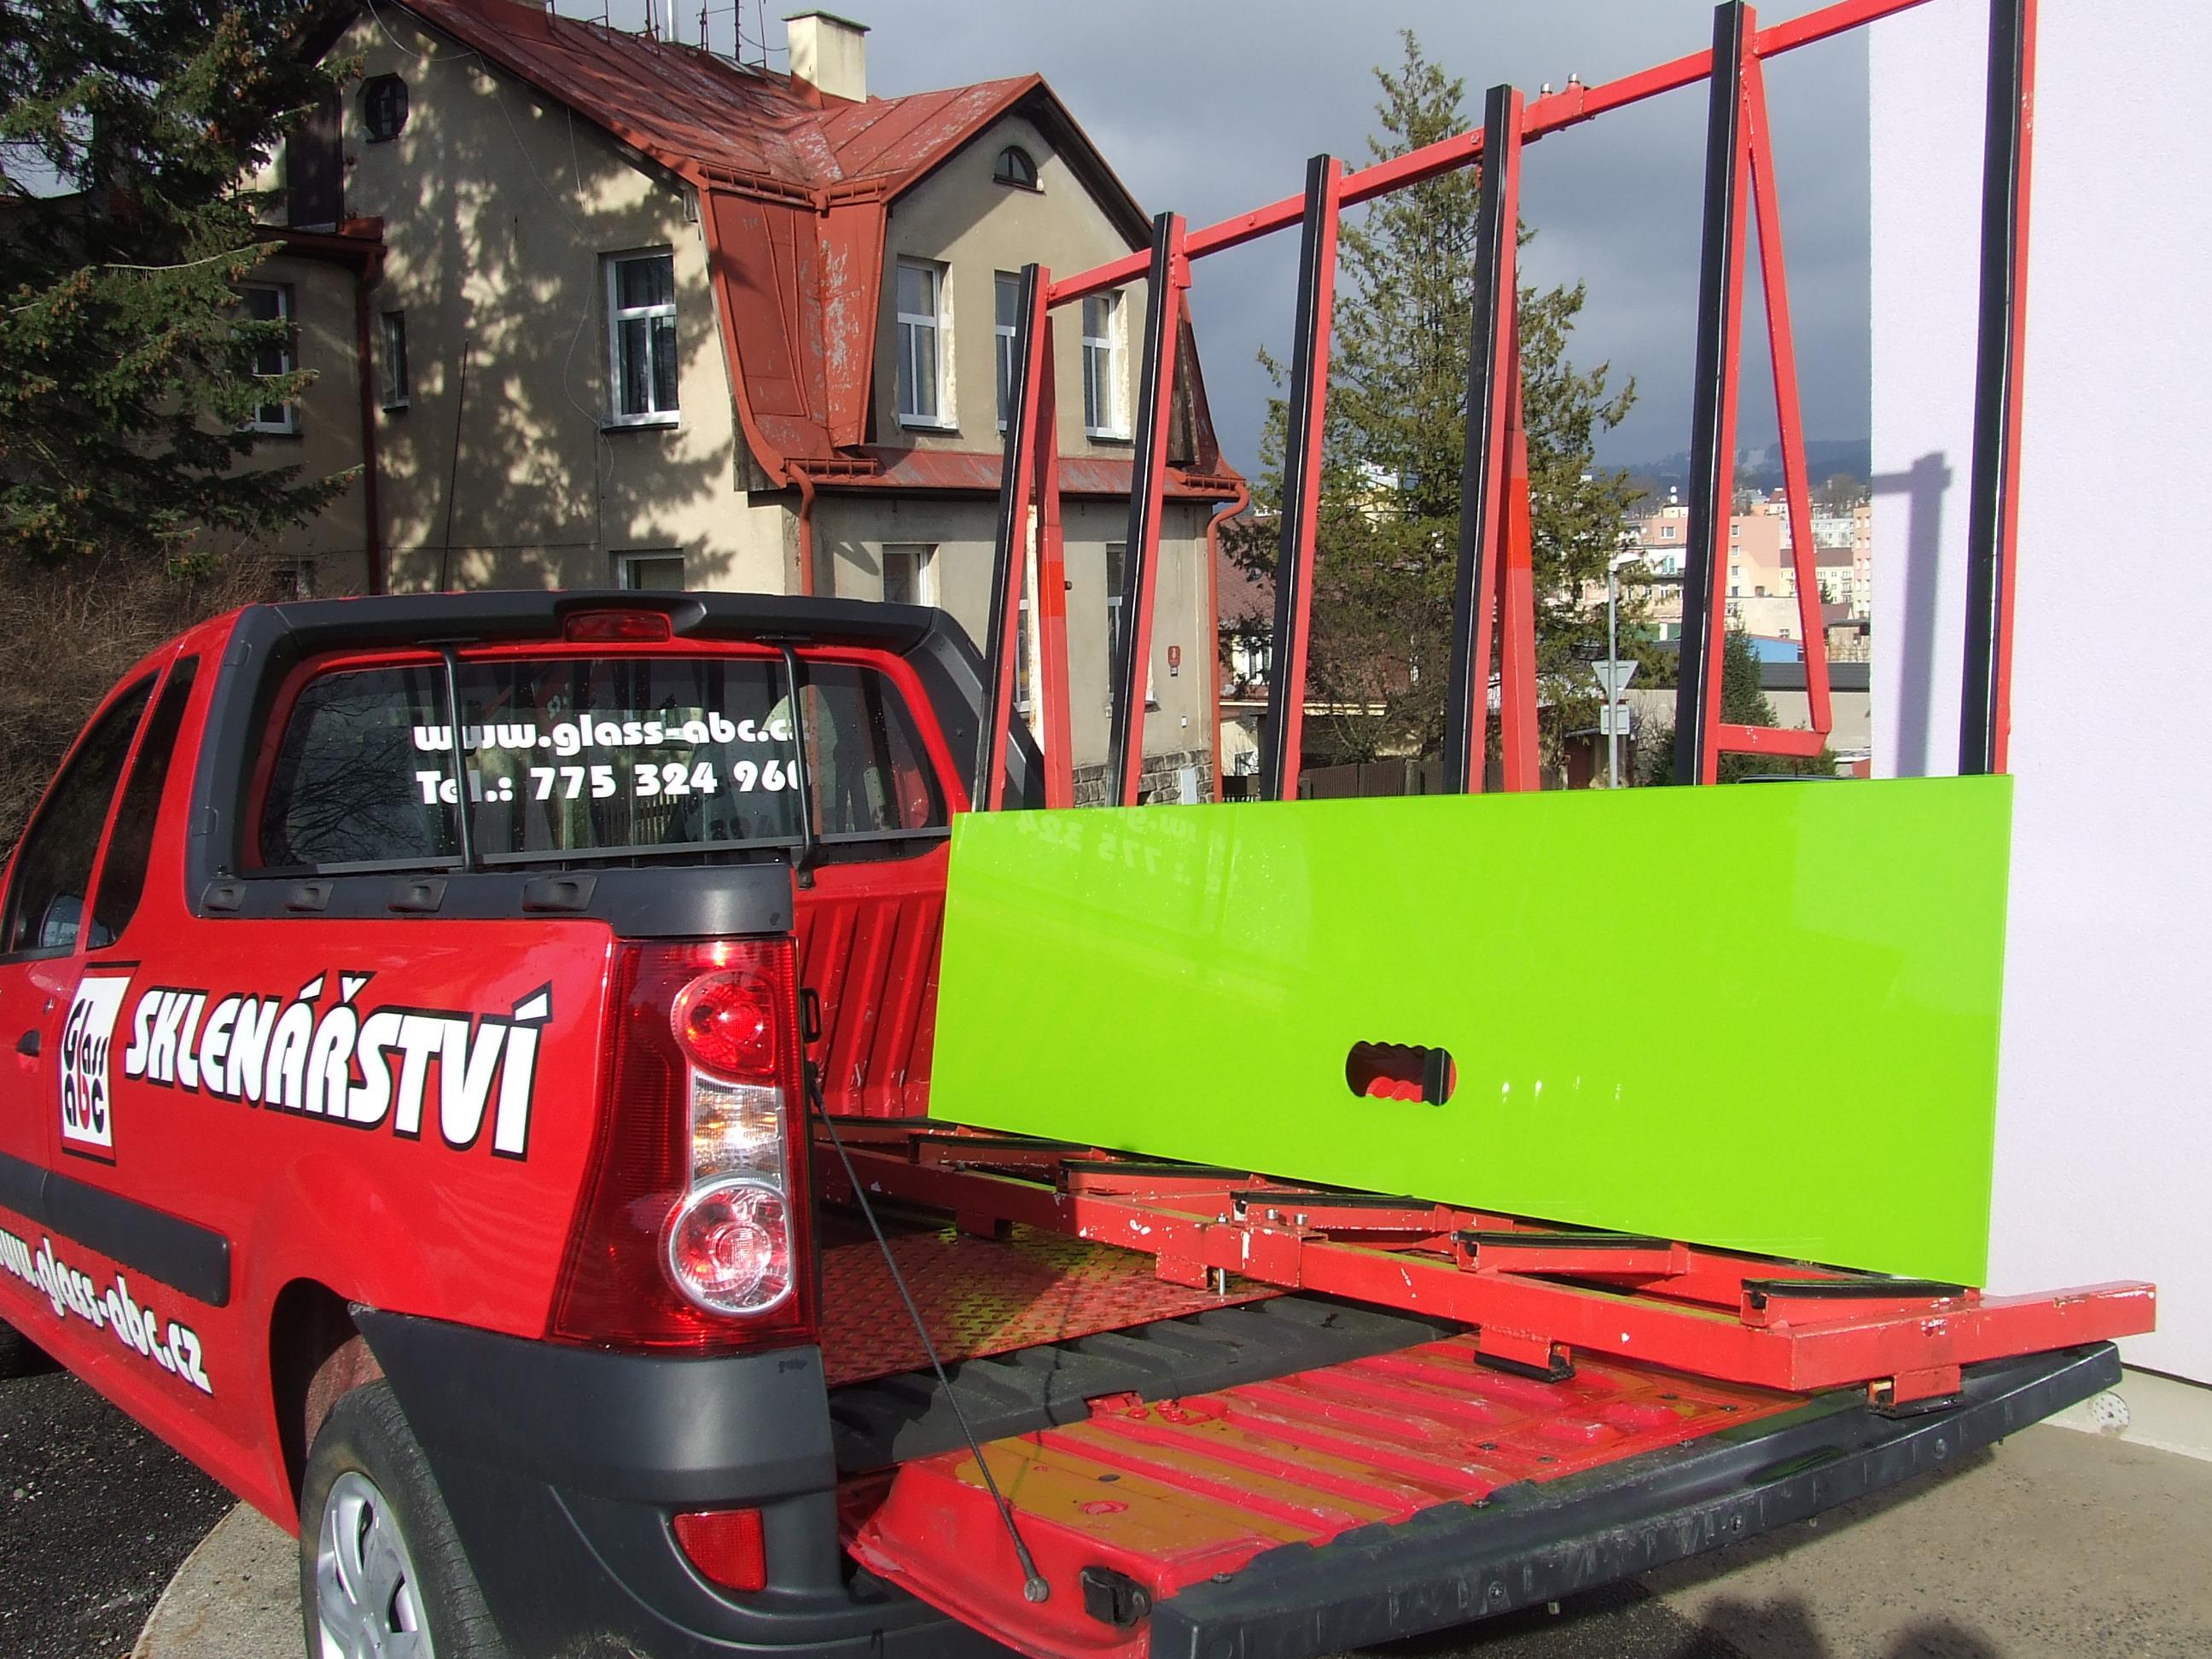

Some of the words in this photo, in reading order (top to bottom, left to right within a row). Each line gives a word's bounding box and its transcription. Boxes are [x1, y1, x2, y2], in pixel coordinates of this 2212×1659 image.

[530, 765, 616, 800] 775
[634, 763, 718, 796] 324
[125, 972, 551, 1160] SKLENÁŘSTVÍ
[0, 1228, 212, 1394] ww.glass-abc.cz
